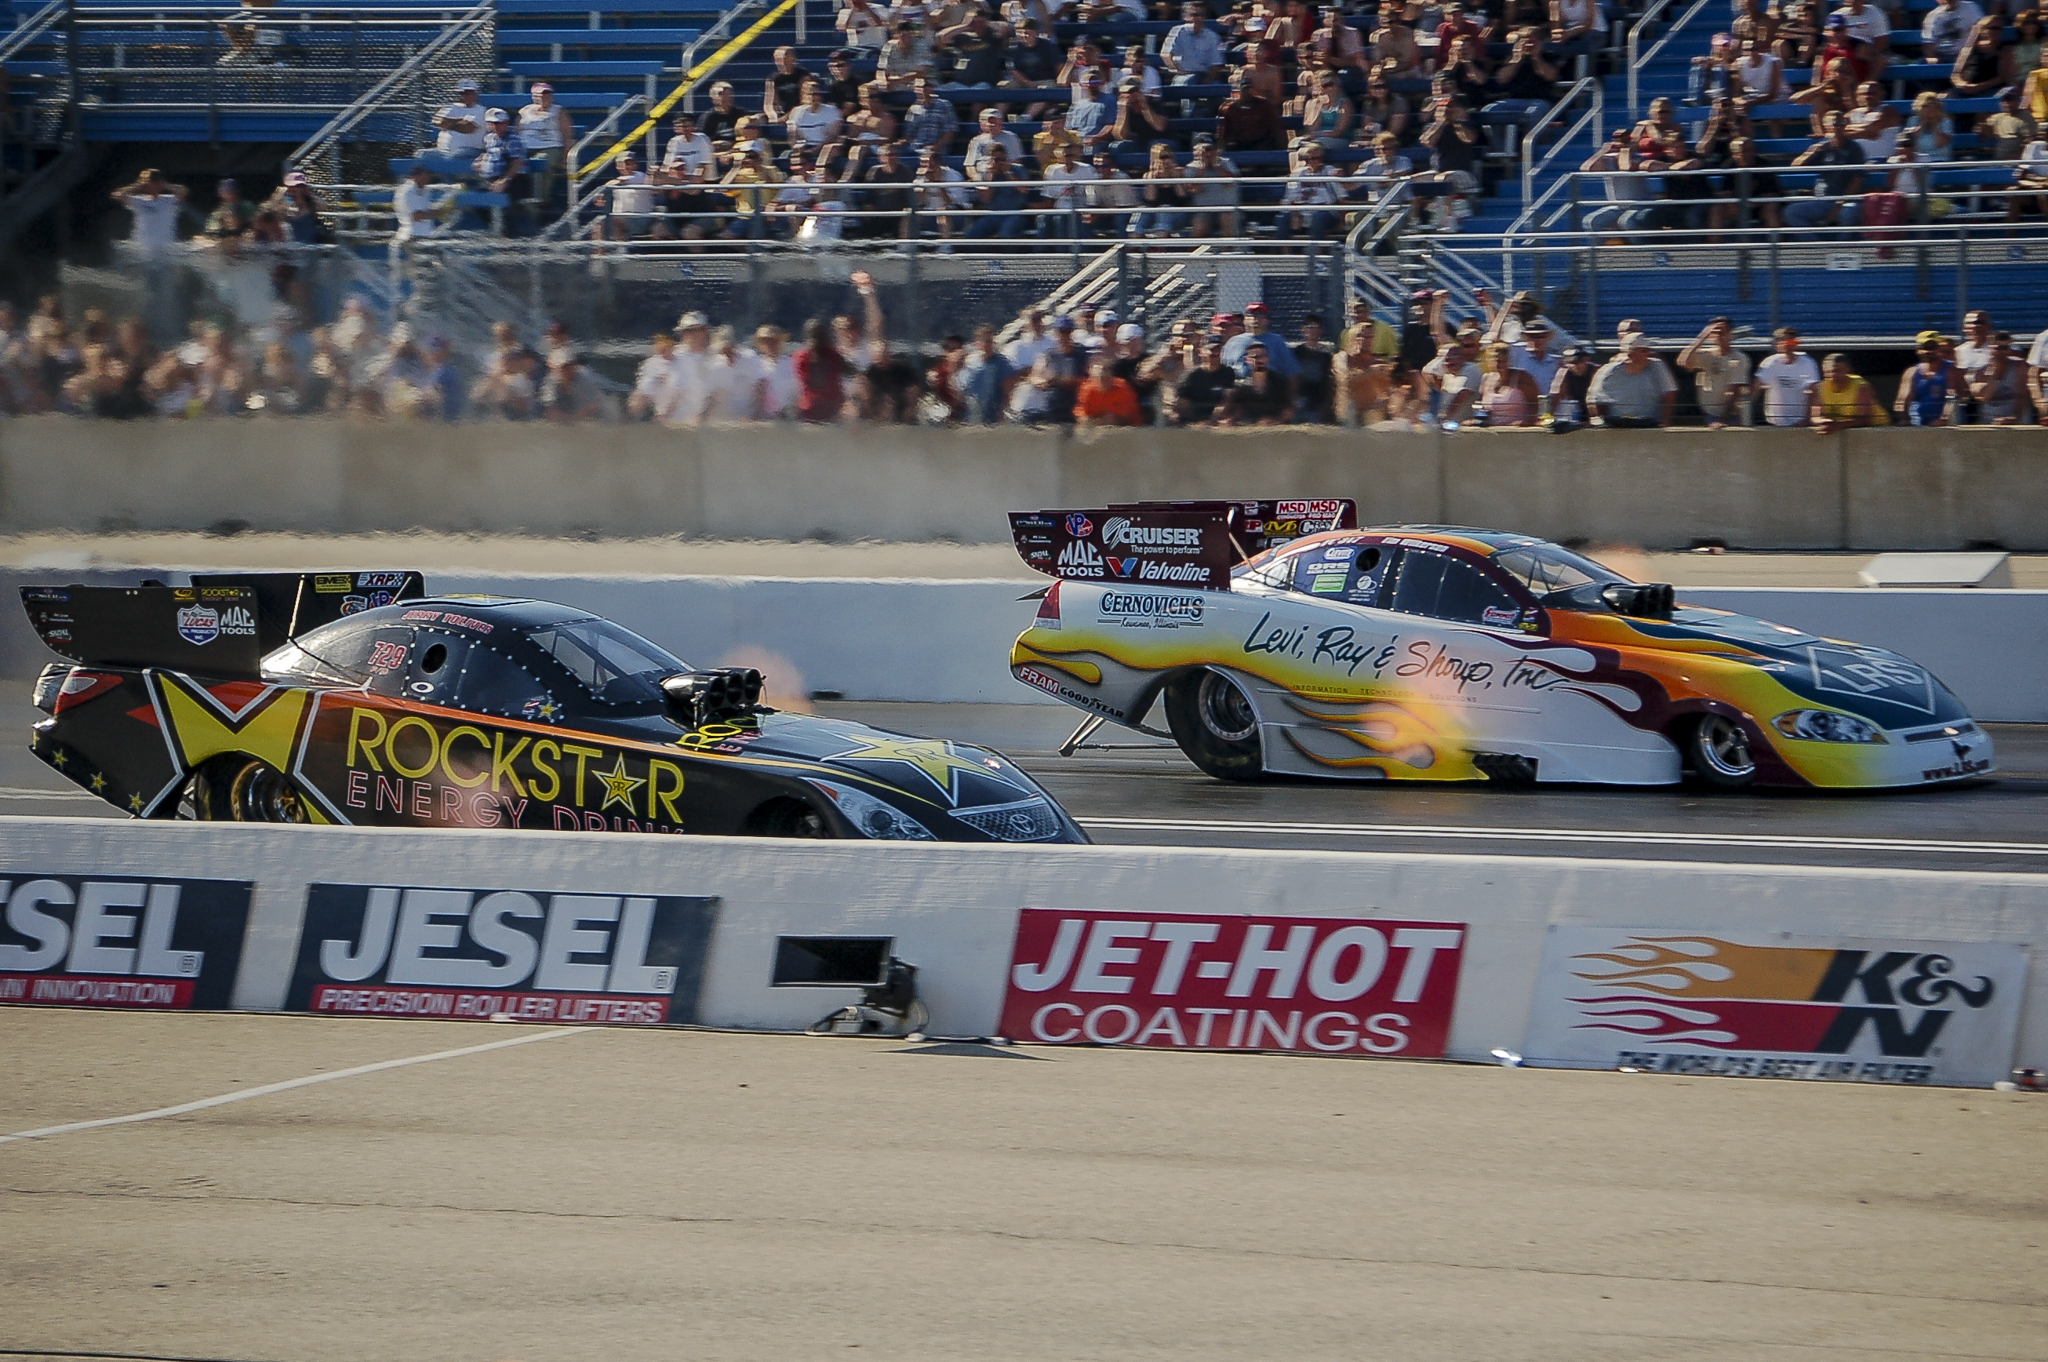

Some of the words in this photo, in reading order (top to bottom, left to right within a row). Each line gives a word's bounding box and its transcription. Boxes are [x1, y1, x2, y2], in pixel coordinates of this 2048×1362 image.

[1279, 502, 1307, 513] MSD
[1310, 501, 1338, 512] MSD
[1120, 528, 1201, 545] CRUISER
[1057, 540, 1104, 566] MAC
[1131, 545, 1143, 553] The
[1143, 546, 1165, 555] power
[1173, 545, 1200, 555] perform
[366, 573, 396, 586] XRP
[1057, 567, 1105, 577] TOOLS
[1139, 560, 1210, 581] Valvoline
[184, 617, 216, 627] LUCAS
[220, 606, 255, 626] MAC
[402, 610, 443, 620] JERRY
[442, 613, 494, 634] TOLIVER
[220, 627, 256, 635] TOOLS
[1244, 611, 1304, 660] Levi,
[1313, 626, 1375, 678] Ray
[1374, 635, 1398, 679] &
[1396, 642, 1493, 692] Shoup,
[1503, 654, 1568, 692] Inc.
[1021, 667, 1059, 693] FRAM
[1821, 661, 1924, 692] LRS
[1292, 684, 1348, 694] INFORMATION
[347, 770, 528, 829] ENERGY
[0, 880, 204, 977] SEL
[319, 887, 679, 994] JESEL
[1012, 918, 1464, 1003] JET-HOT
[31, 979, 178, 1003] INNOVATION
[318, 989, 453, 1014] PRECISION
[454, 994, 558, 1019] ROLLER
[558, 999, 664, 1024] LIFTERS
[1030, 1003, 1411, 1053] COATINGS
[1617, 1050, 1658, 1070] THE
